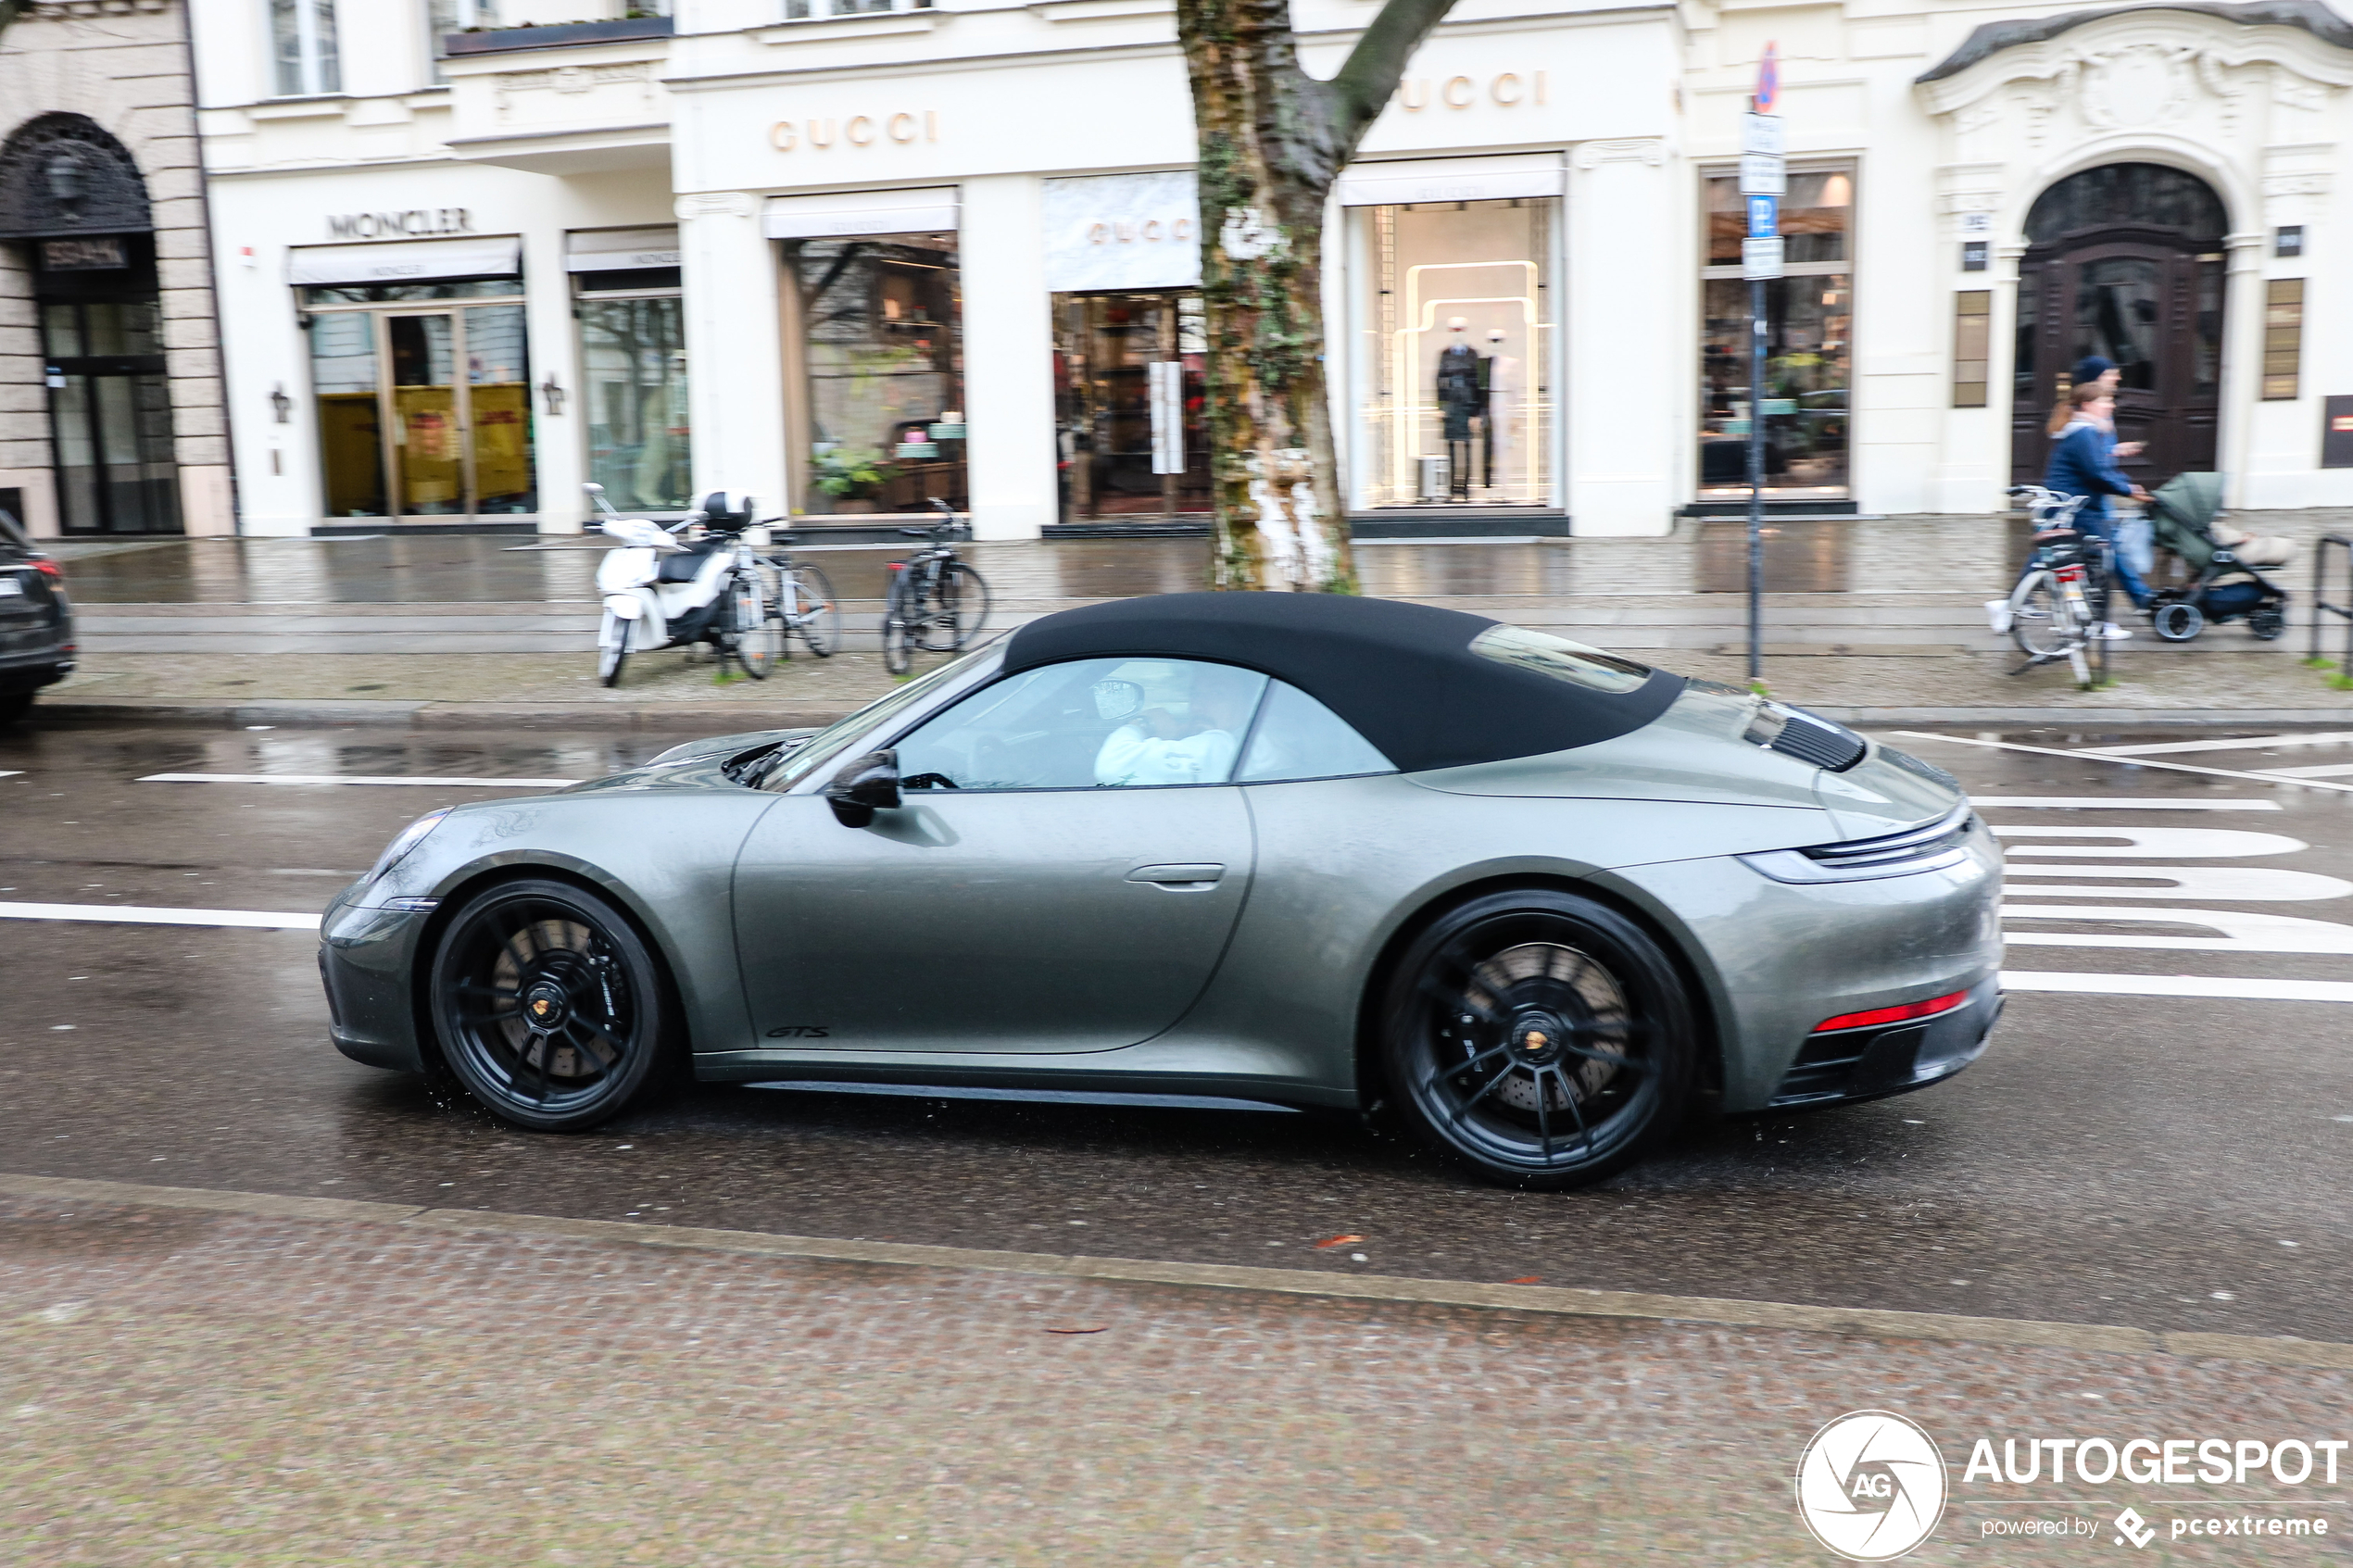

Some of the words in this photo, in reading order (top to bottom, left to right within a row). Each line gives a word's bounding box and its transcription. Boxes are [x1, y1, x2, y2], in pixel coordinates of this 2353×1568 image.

[1393, 70, 1550, 112] UCCI
[769, 110, 939, 152] GUCCI
[327, 207, 475, 238] MONCLER
[1087, 219, 1195, 245] GUCC
[766, 1026, 829, 1038] GTS
